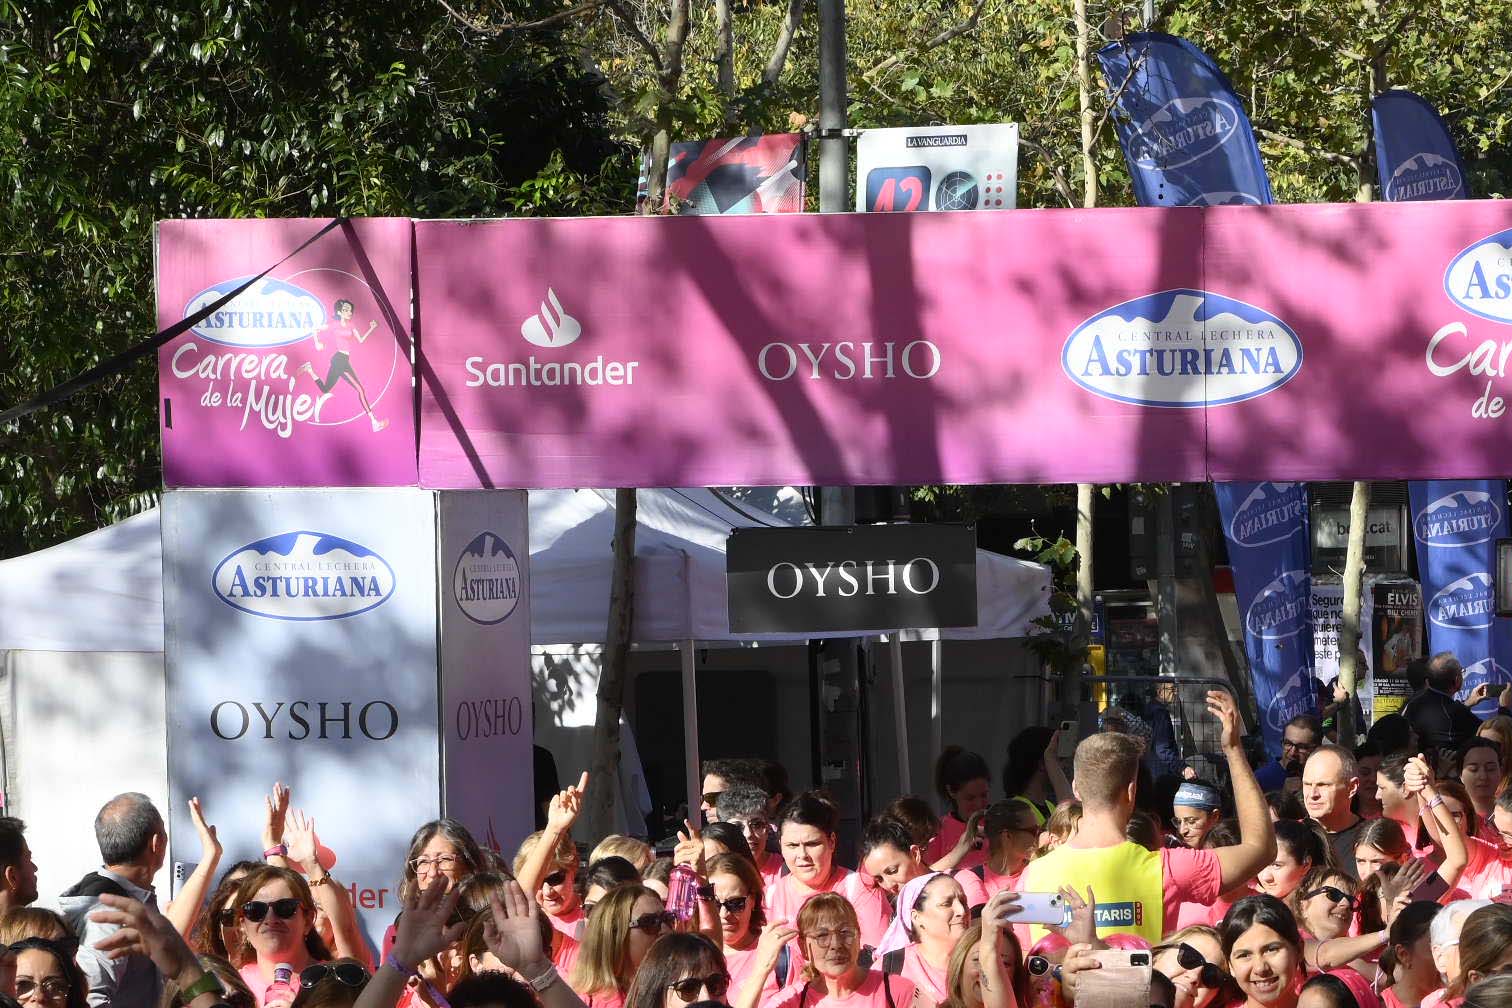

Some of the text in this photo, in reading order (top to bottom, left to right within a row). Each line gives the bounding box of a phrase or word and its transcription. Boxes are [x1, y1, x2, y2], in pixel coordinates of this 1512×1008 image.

[195, 302, 315, 329] ASTURIANA
[1117, 329, 1276, 341] CENTRAL LECHERA
[171, 342, 289, 380] Carrera
[466, 356, 639, 388] Santander
[757, 341, 941, 381] OYSHO
[1081, 334, 1284, 377] ASTURIANA
[200, 376, 334, 439] de la Mujer
[1472, 380, 1505, 418] de
[227, 565, 383, 599] ASTURIANA
[459, 567, 517, 602] ASTURIANA
[767, 557, 941, 598] OYSHO
[1387, 593, 1418, 606] ELVIS
[209, 701, 399, 741] OYSHO
[456, 696, 522, 741] OYSHO
